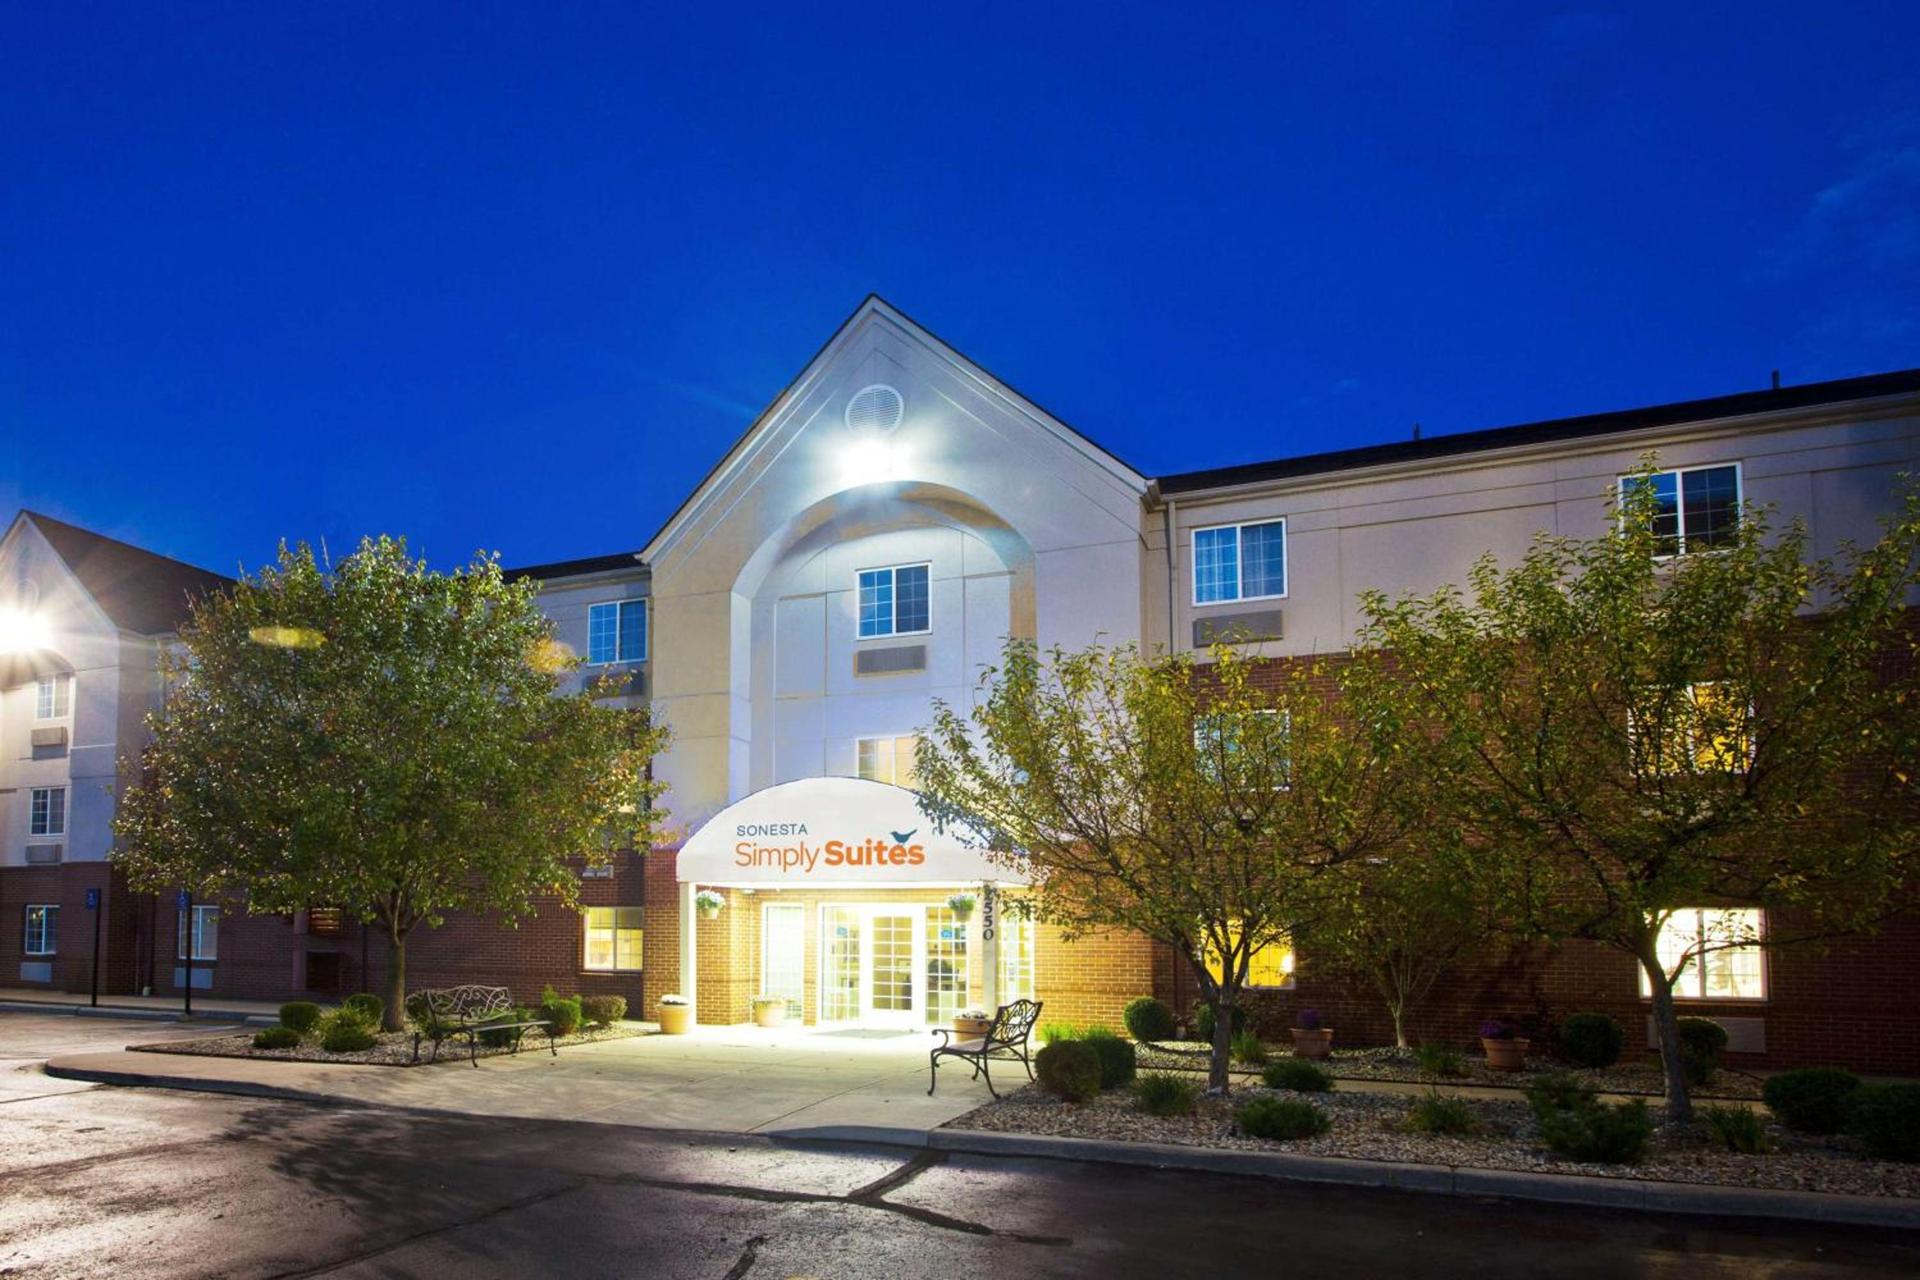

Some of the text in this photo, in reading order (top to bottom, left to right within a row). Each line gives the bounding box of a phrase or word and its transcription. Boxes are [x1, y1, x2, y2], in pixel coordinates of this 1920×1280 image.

[736, 823, 808, 837] SONESTA
[735, 838, 925, 873] Simply Suites
